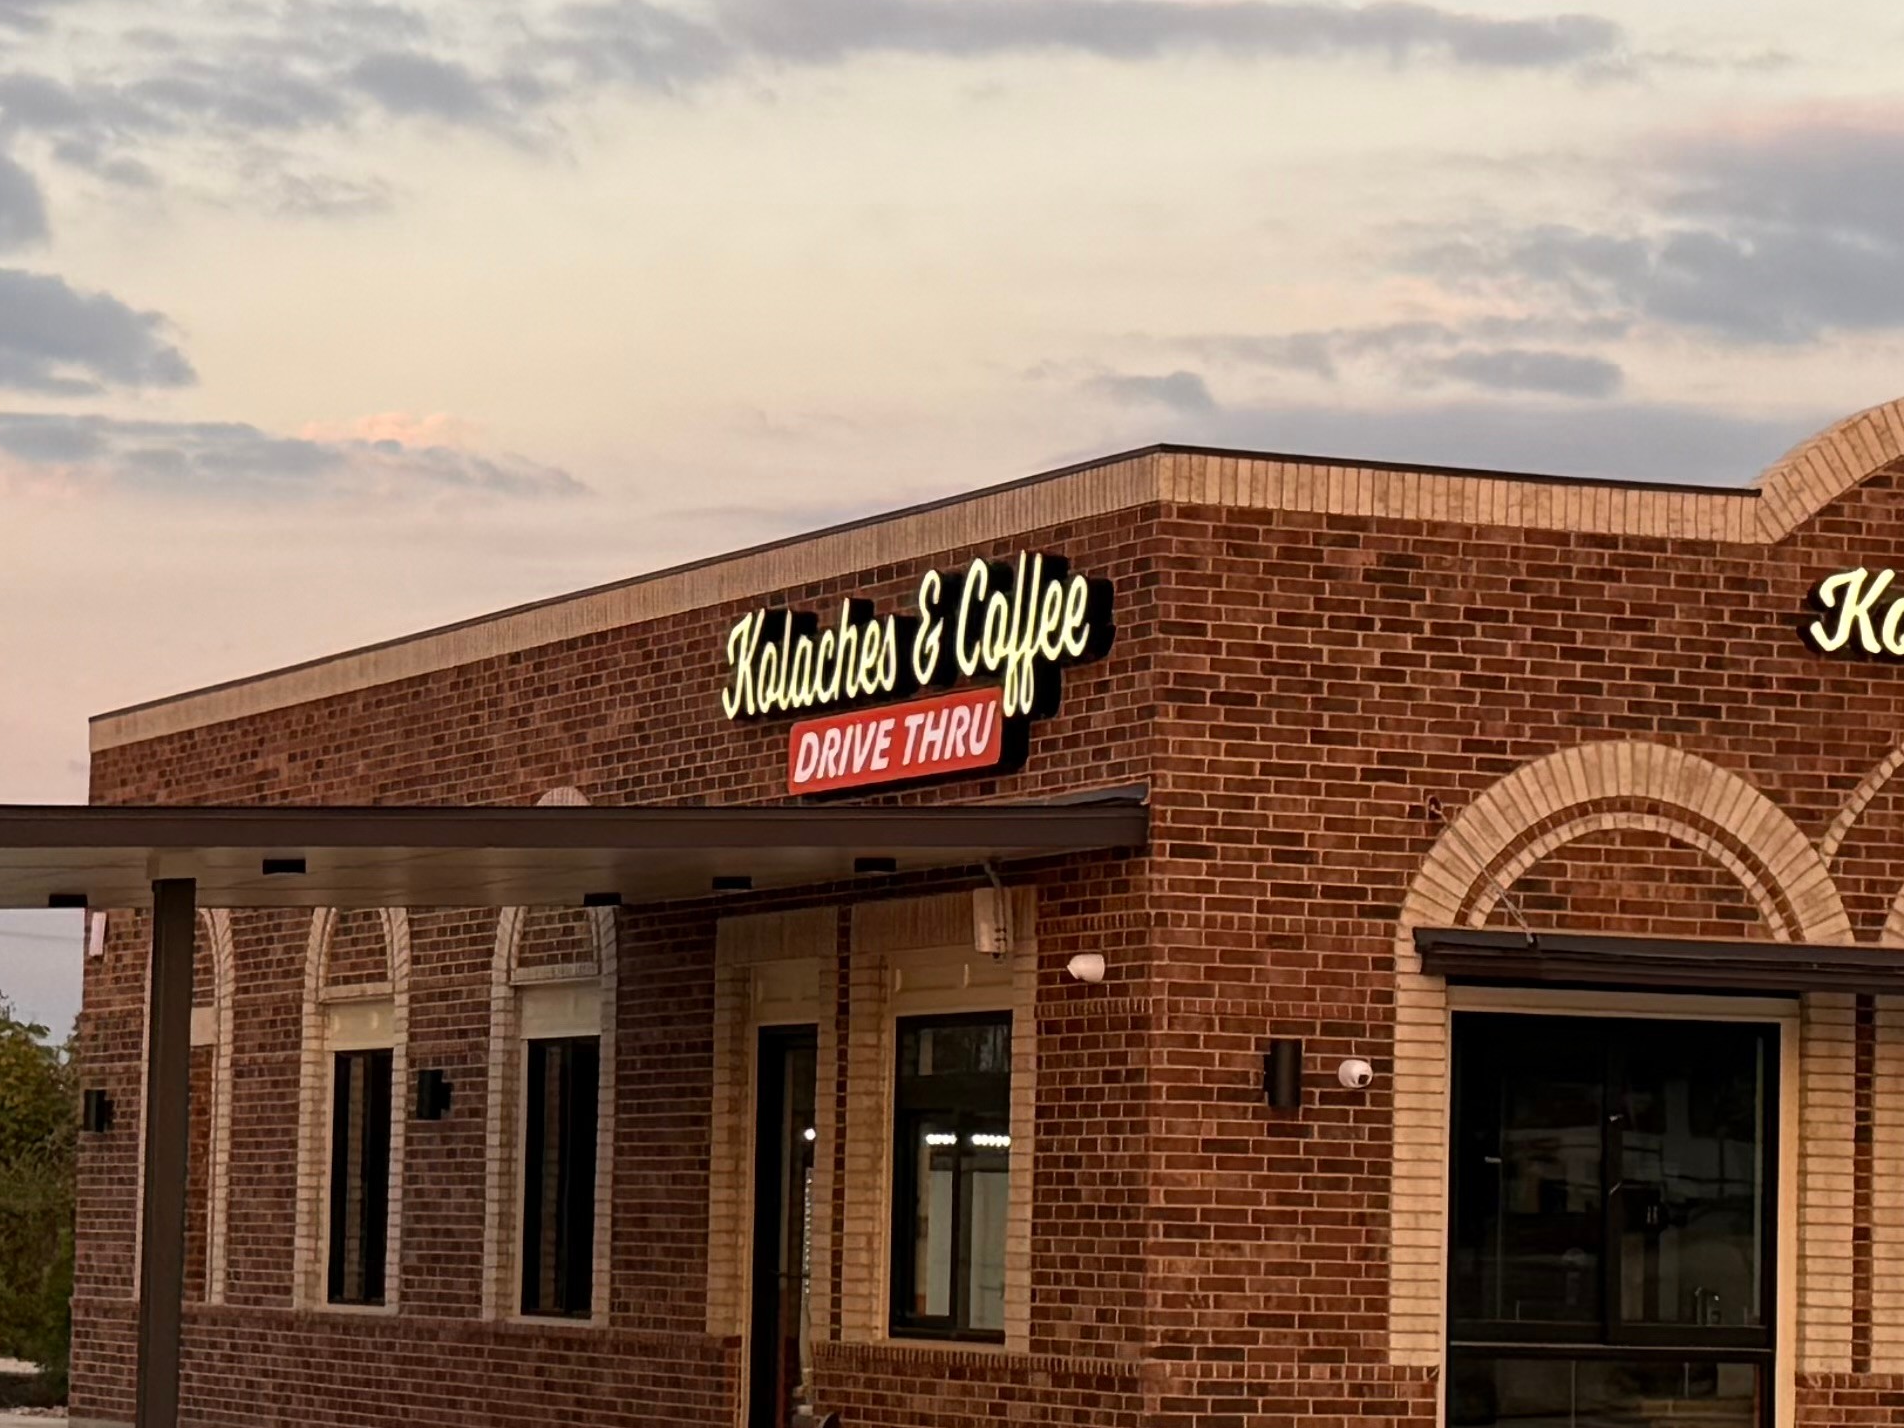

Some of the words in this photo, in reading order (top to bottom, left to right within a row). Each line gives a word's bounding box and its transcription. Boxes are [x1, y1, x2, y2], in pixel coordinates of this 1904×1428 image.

[721, 597, 897, 720] Kolaches
[912, 569, 944, 685] &
[956, 549, 1091, 718] Coffee
[793, 718, 895, 784] DRIVE
[902, 700, 997, 766] THRU
